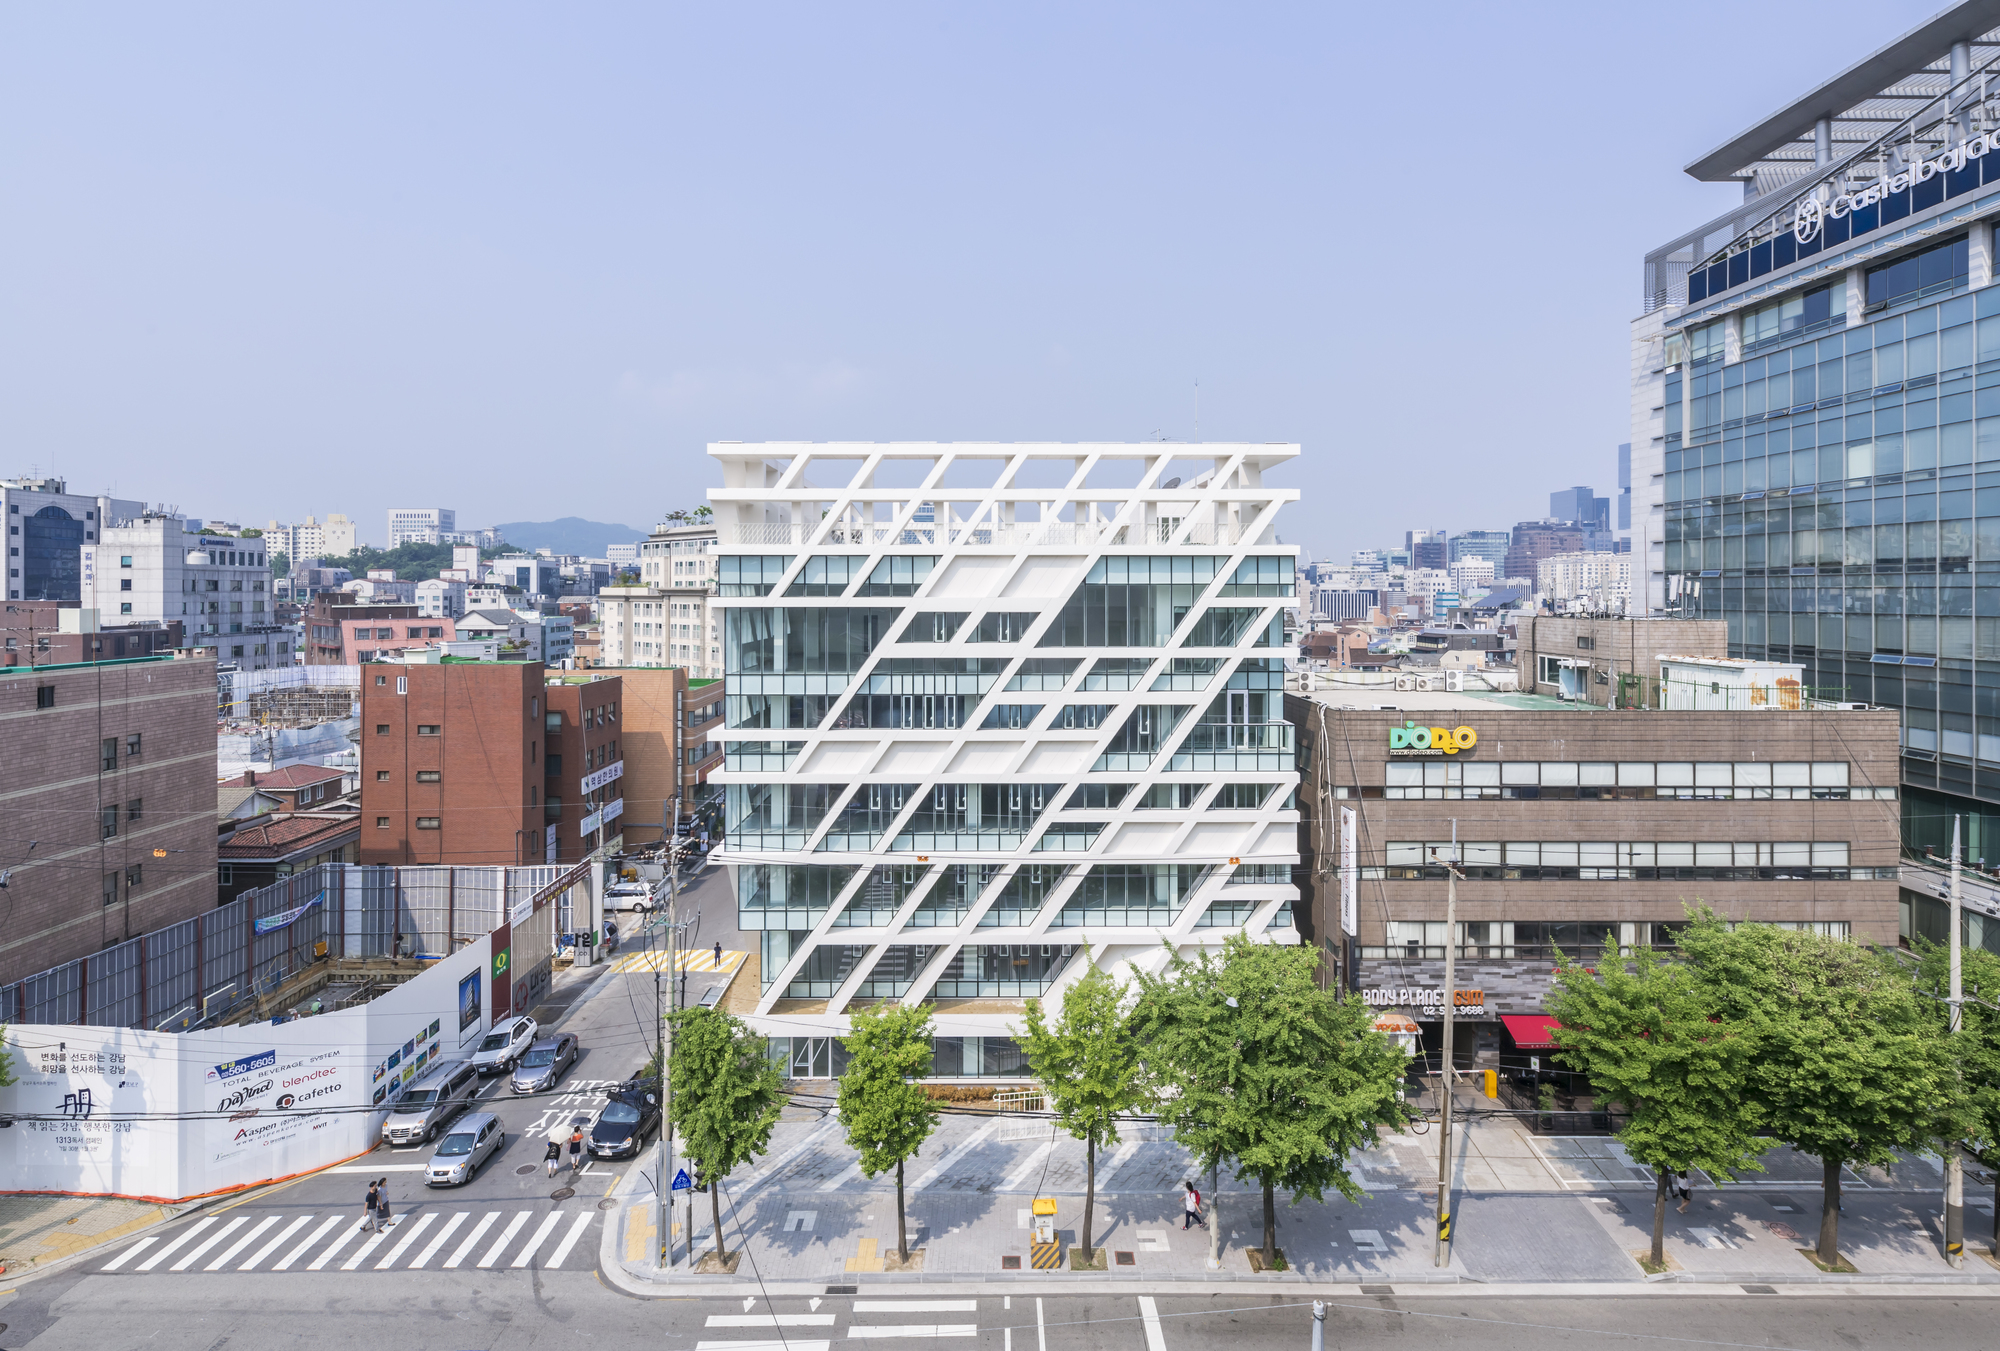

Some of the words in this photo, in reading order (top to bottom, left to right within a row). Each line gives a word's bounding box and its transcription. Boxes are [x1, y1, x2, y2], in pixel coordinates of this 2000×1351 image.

[1362, 989, 1397, 1006] BODY
[1453, 989, 1484, 1006] GYM
[1423, 1006, 1436, 1015] 02
[1460, 1006, 1484, 1015] 9688
[41, 1053, 67, 1062] 변화를
[70, 1053, 105, 1062] 선도하는
[109, 1053, 126, 1063] 강남
[41, 1065, 67, 1074] 희망을
[70, 1065, 105, 1074] 선사하는
[109, 1065, 126, 1074] 강남
[222, 1076, 252, 1088] TOTAL
[258, 1060, 304, 1078] BEVERAGE
[310, 1050, 341, 1063] SYSTEM
[282, 1067, 337, 1088] blendtec
[298, 1082, 342, 1102] cafetto
[28, 1121, 37, 1132] 책
[39, 1121, 58, 1132] 읽는
[83, 1122, 111, 1132] 행복한
[113, 1122, 131, 1132] 강남
